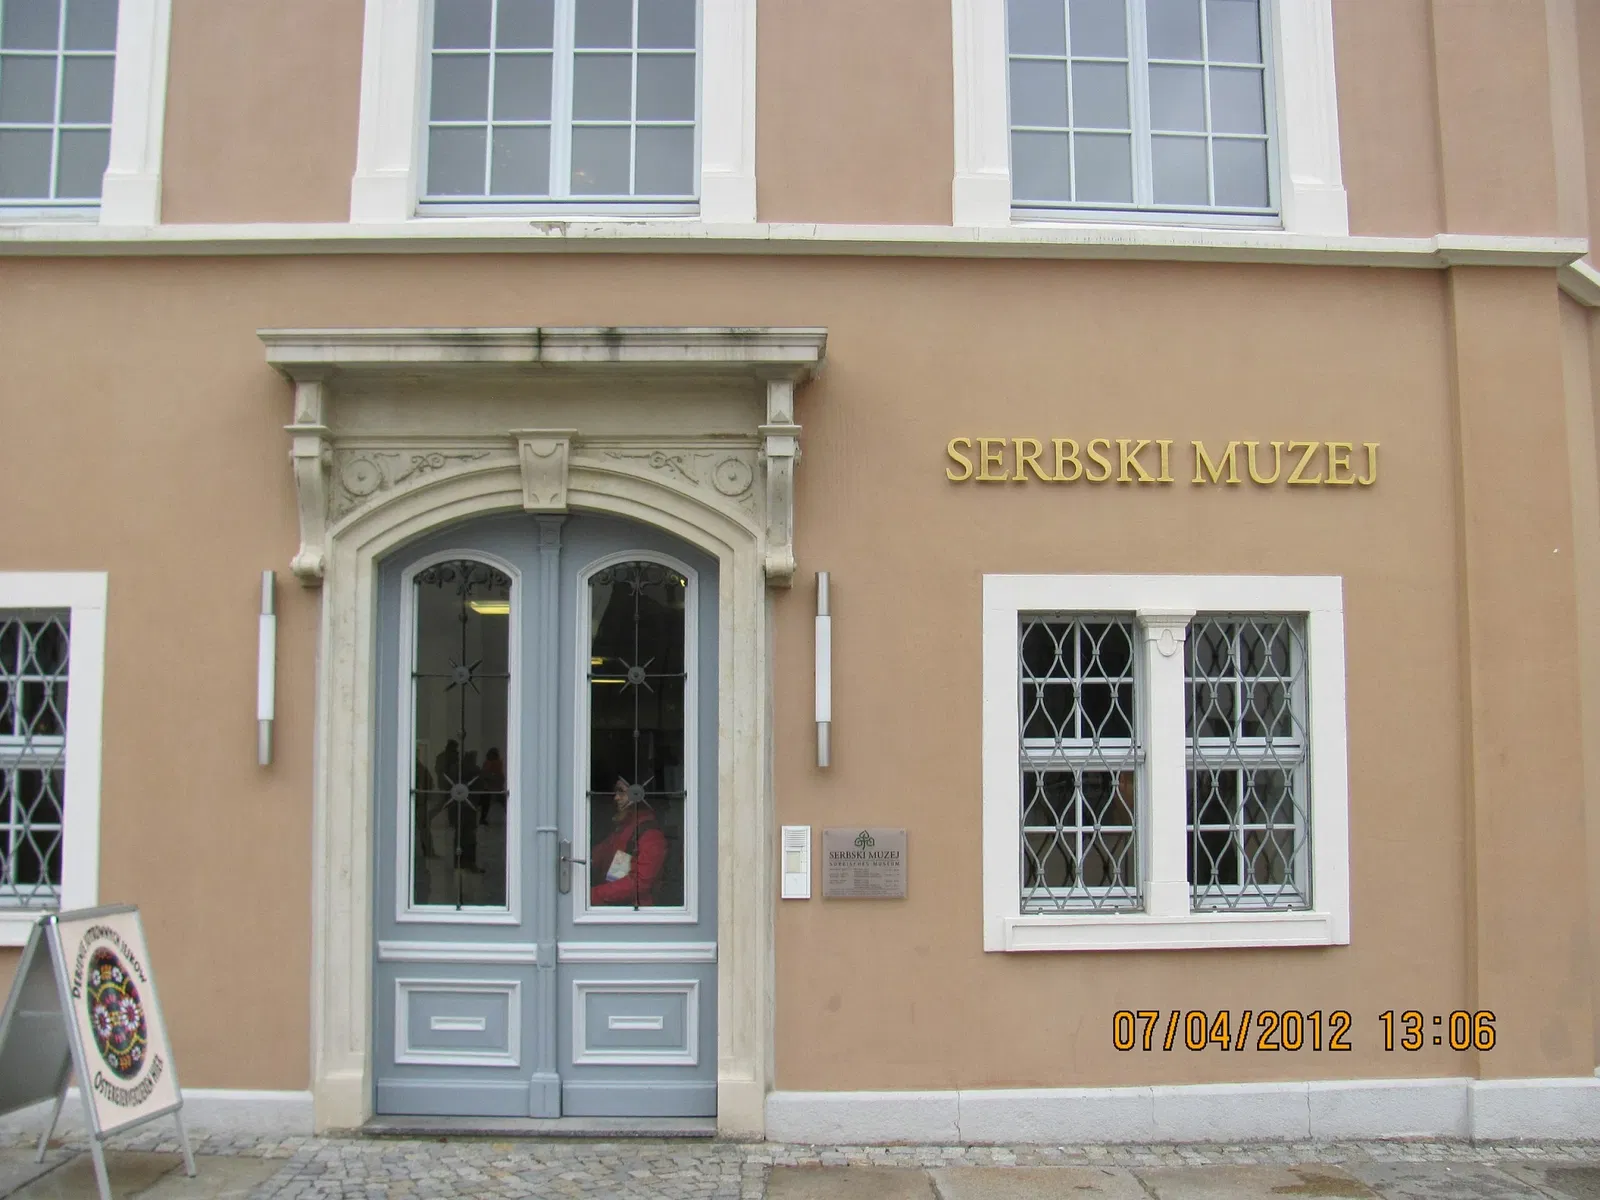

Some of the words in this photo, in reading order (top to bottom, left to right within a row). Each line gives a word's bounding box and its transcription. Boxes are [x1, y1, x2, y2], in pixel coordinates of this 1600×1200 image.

[946, 436, 1175, 483] SERBSKI
[1191, 440, 1380, 486] MUZEJ
[829, 850, 866, 860] SERBSKI
[868, 850, 900, 860] MUZEJ
